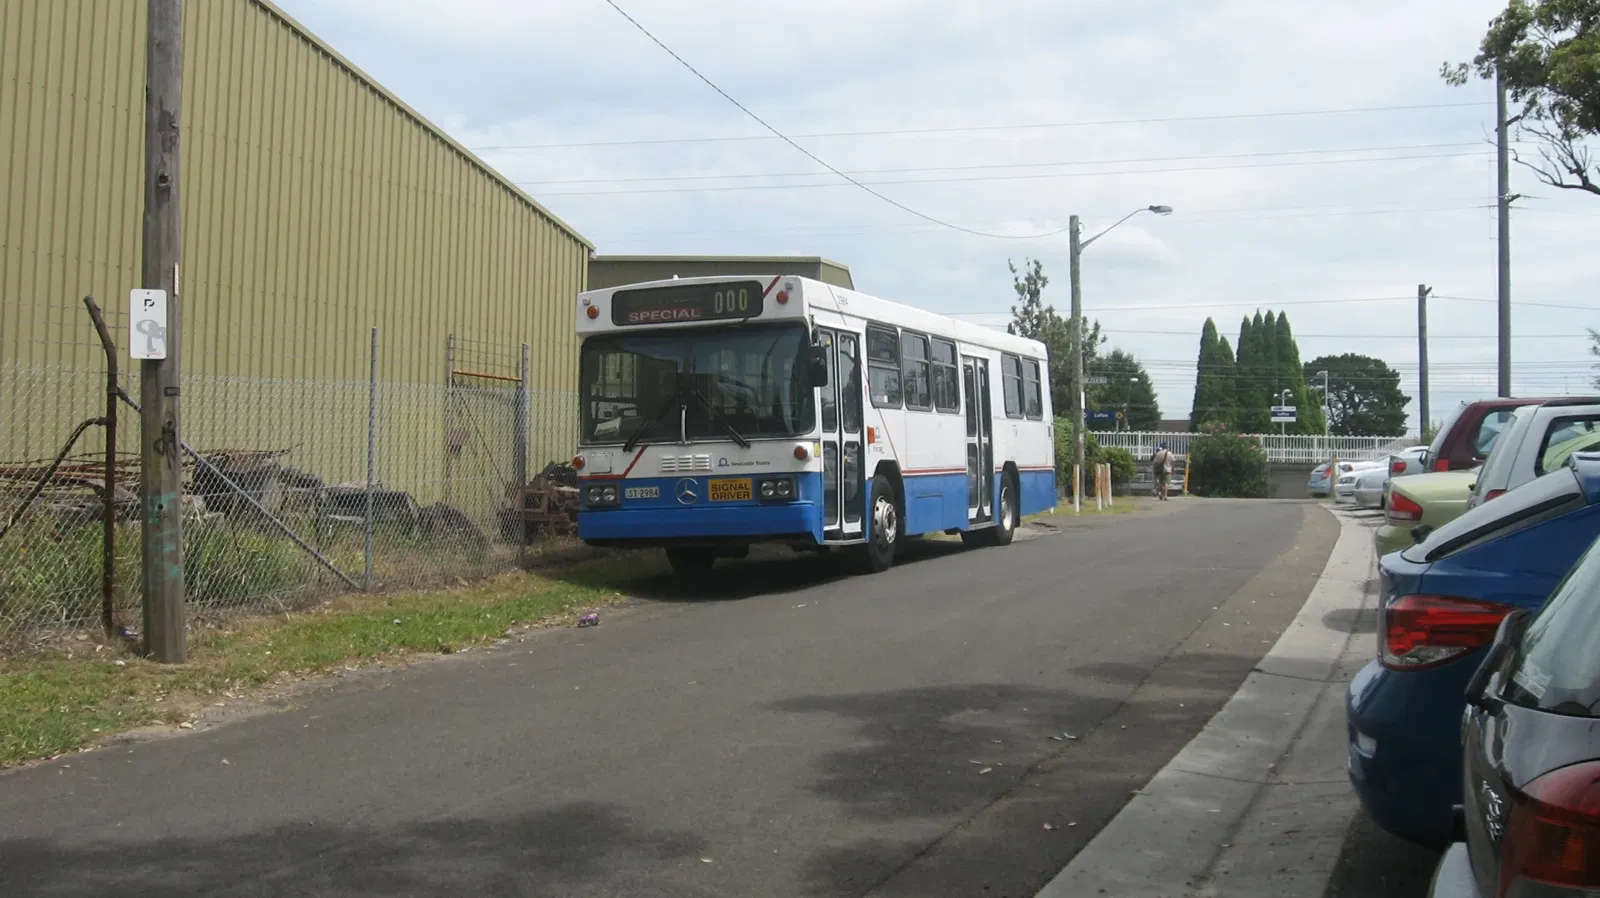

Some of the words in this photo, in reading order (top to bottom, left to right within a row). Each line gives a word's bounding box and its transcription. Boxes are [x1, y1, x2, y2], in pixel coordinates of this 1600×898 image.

[628, 308, 701, 322] SPECIAL
[711, 483, 750, 492] SIGNAL
[639, 488, 659, 498] 2984
[711, 490, 750, 500] DRIVER
